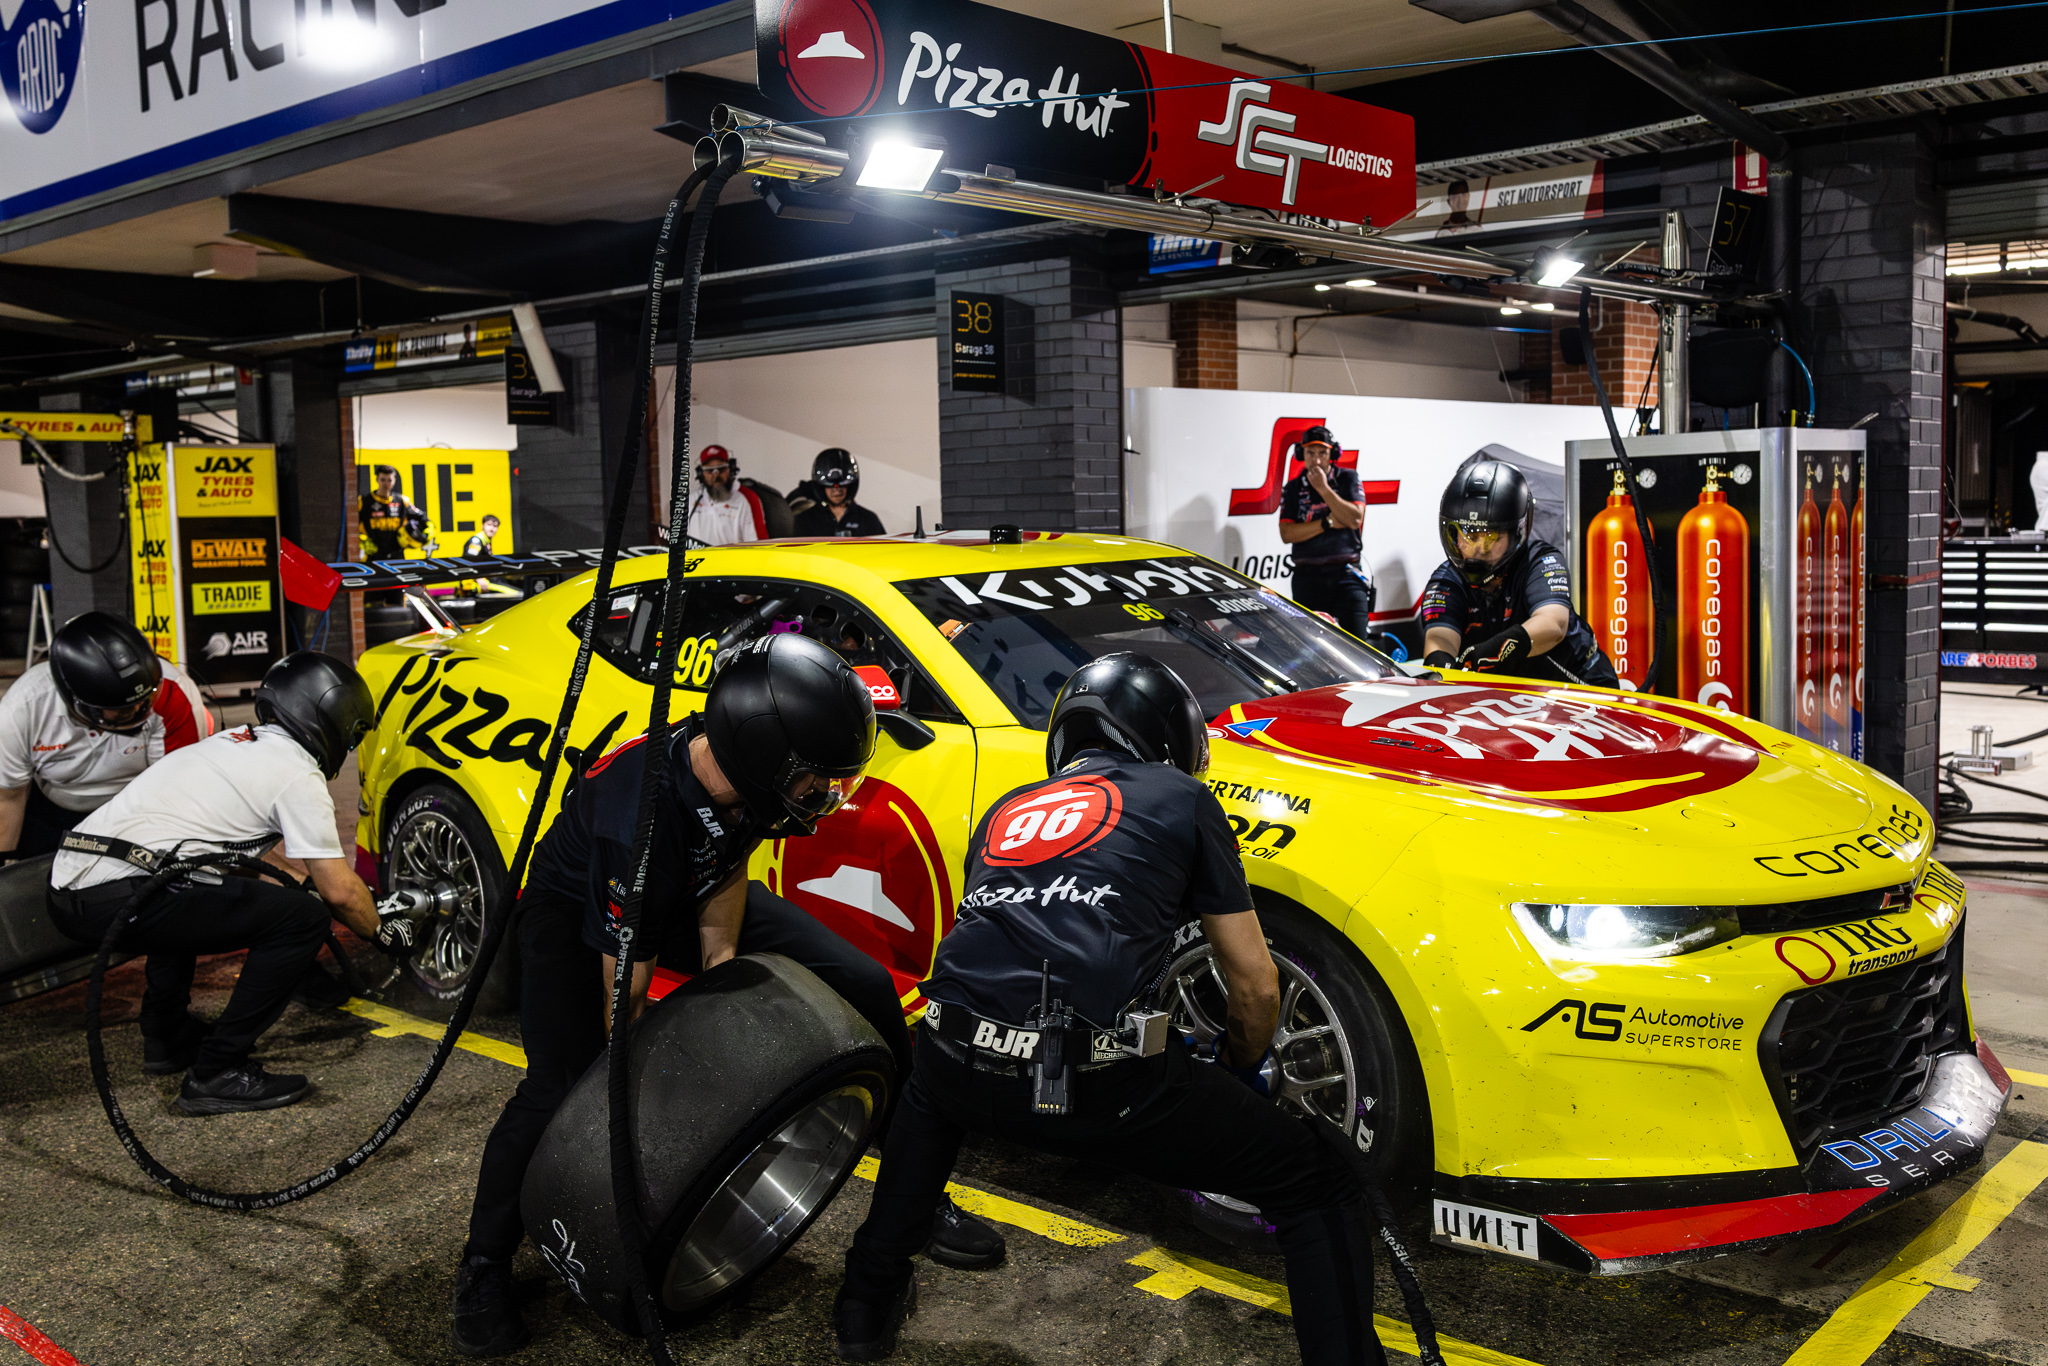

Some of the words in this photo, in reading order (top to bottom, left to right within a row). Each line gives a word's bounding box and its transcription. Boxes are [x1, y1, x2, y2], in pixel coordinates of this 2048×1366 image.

[17, 18, 65, 114] ARDC
[898, 31, 1033, 118] Pizza
[1038, 66, 1130, 139] Hut
[1197, 77, 1329, 205] SCT
[1328, 146, 1393, 178] LOGISTICS
[1497, 189, 1516, 207] SCT
[1518, 180, 1583, 204] MOTORSPORT
[1718, 201, 1751, 247] 37
[653, 261, 665, 290] FLUID
[957, 300, 992, 333] 38
[955, 342, 983, 356] Garage
[14, 420, 74, 433] TYRES
[90, 421, 124, 433] AUT
[134, 462, 161, 482] JAX
[194, 456, 254, 473] JAX
[202, 476, 254, 486] TYRES
[196, 488, 207, 498] &
[210, 488, 253, 498] AUTO
[669, 495, 686, 545] PRESSURE
[138, 540, 165, 558] JAX
[201, 585, 262, 602] TRADIE
[939, 559, 1247, 611] Kubota
[1122, 602, 1165, 622] 96
[1208, 595, 1268, 614] Jones
[1610, 540, 1628, 675] coregas
[1702, 538, 1721, 678] coregas
[1804, 536, 1813, 675] coregas
[1831, 535, 1840, 670] coregas
[142, 615, 170, 634] JAX
[232, 631, 268, 648] AIR
[581, 619, 594, 650] UNDER
[570, 650, 589, 697] PRESSURE
[673, 636, 718, 686] 96
[373, 650, 552, 772] Pizza
[1387, 692, 1551, 760] Pizza
[696, 806, 724, 838] BJR
[1000, 801, 1090, 851] 96
[1252, 846, 1280, 861] Oil
[1753, 803, 1923, 878] coregas
[1041, 874, 1121, 907] Hut
[1921, 862, 1965, 906] TRG
[1813, 916, 1913, 958] TRG
[614, 941, 630, 981] PIRTEK
[1847, 943, 1918, 977] transport
[1629, 1006, 1744, 1030] Automotive
[972, 1020, 1041, 1060] BJR
[1094, 1050, 1130, 1061] MECHANI
[1624, 1032, 1742, 1051] SUPERSTORE
